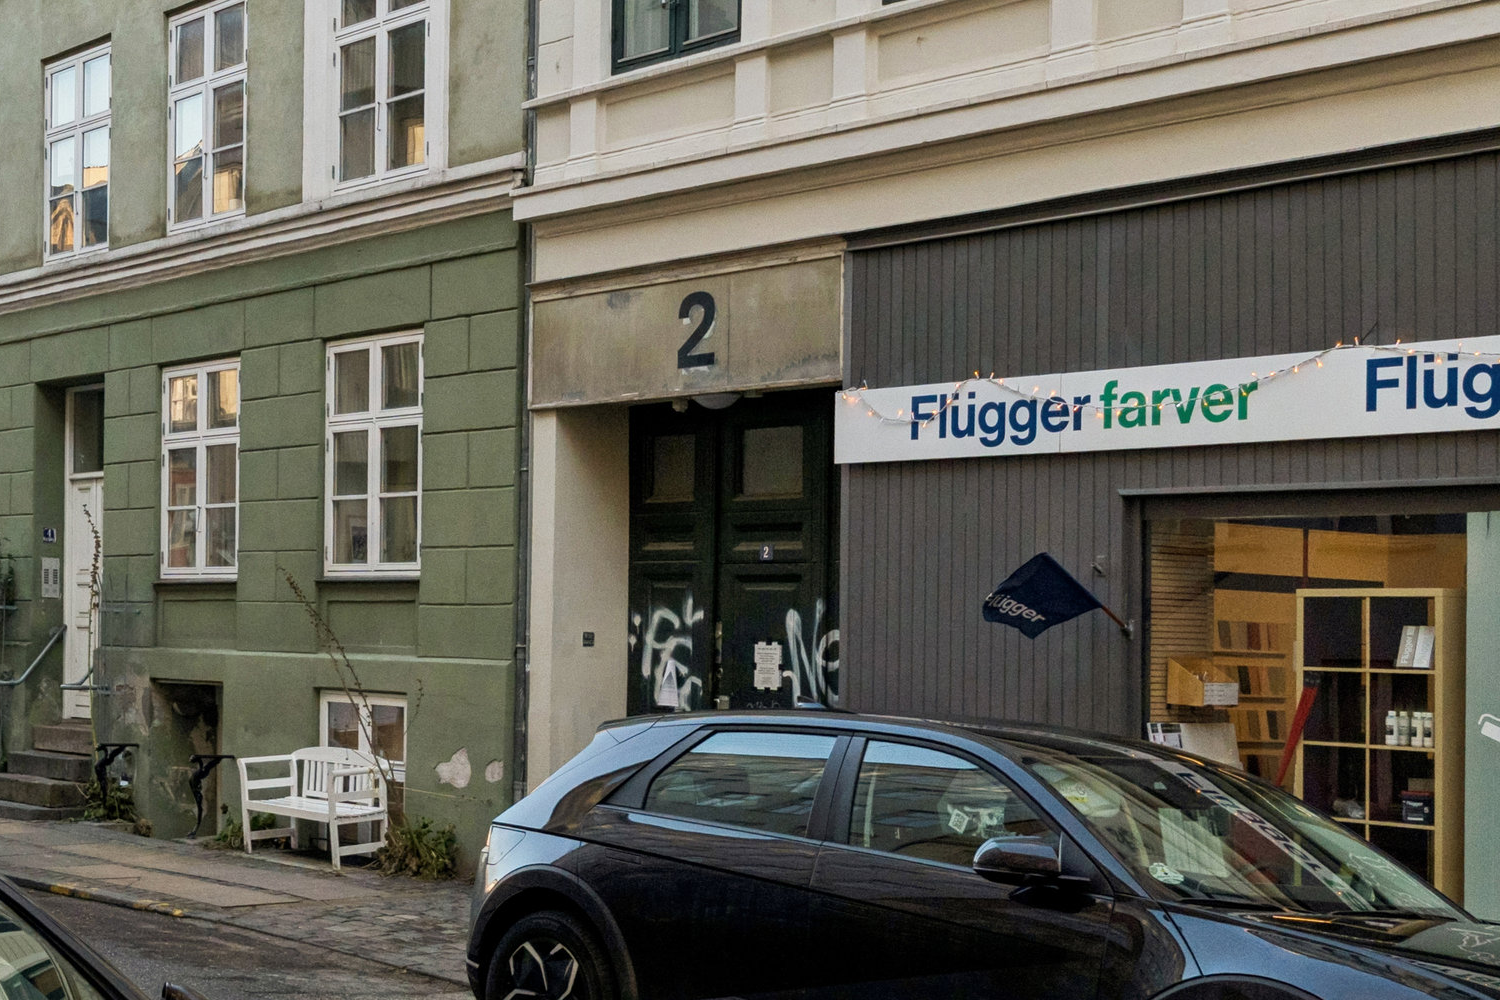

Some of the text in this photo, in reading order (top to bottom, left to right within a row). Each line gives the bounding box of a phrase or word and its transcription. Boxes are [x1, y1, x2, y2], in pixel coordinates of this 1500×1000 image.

[676, 290, 717, 370] 2
[910, 379, 1259, 448] Flügger farver
[1365, 352, 1500, 419] Flüg
[763, 545, 769, 558] 2
